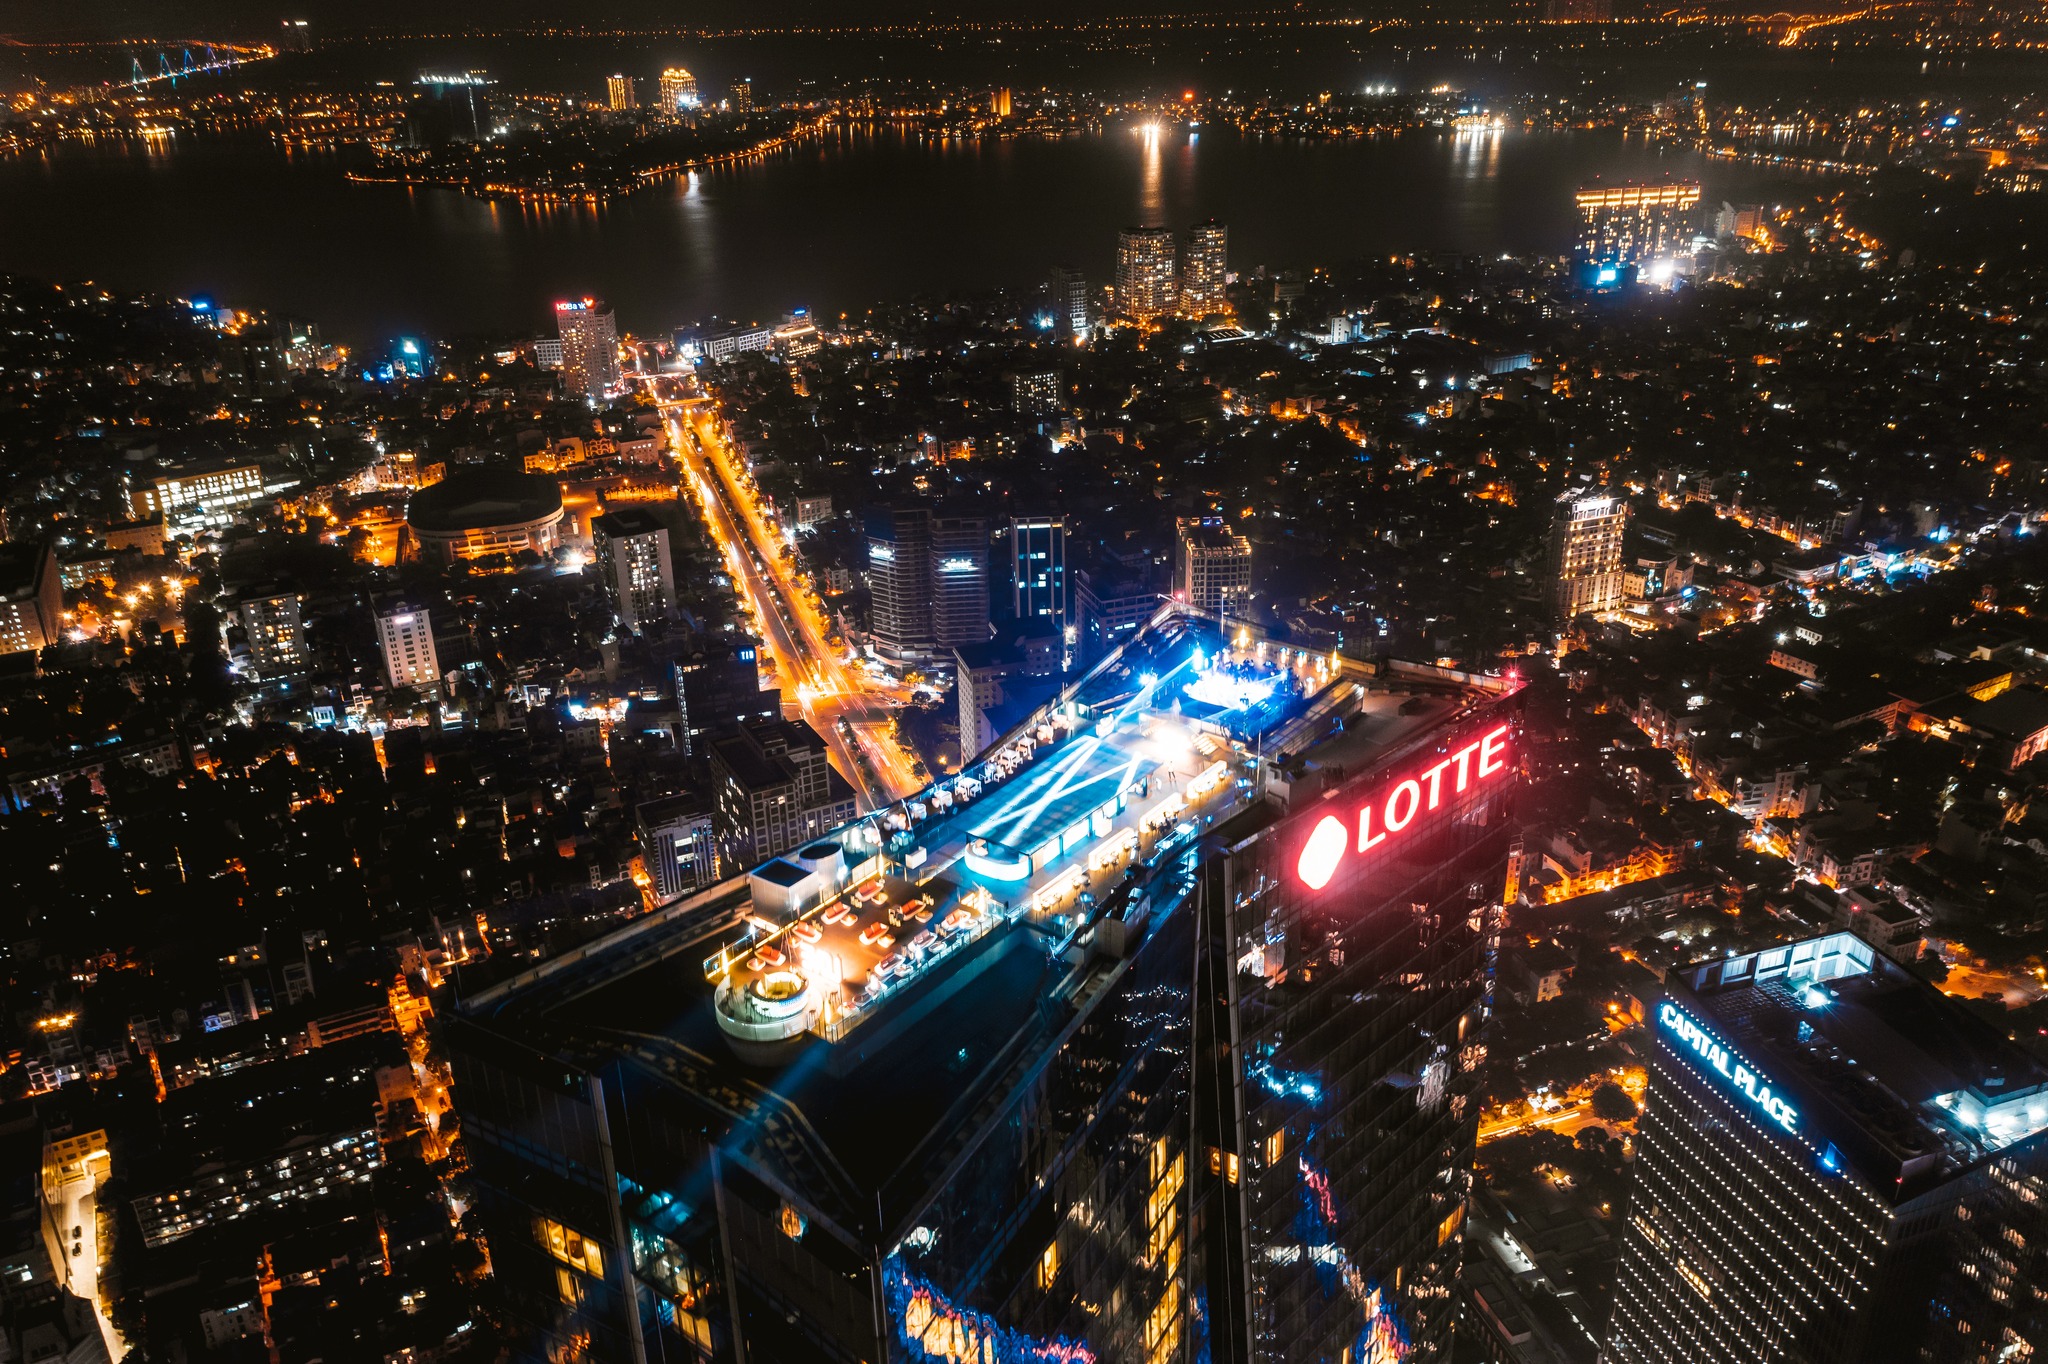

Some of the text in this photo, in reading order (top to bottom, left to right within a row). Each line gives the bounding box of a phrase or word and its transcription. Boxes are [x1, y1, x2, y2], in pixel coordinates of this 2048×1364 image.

[1358, 725, 1508, 854] LOTTE
[1661, 1004, 1798, 1133] CAPITAL PLACE
